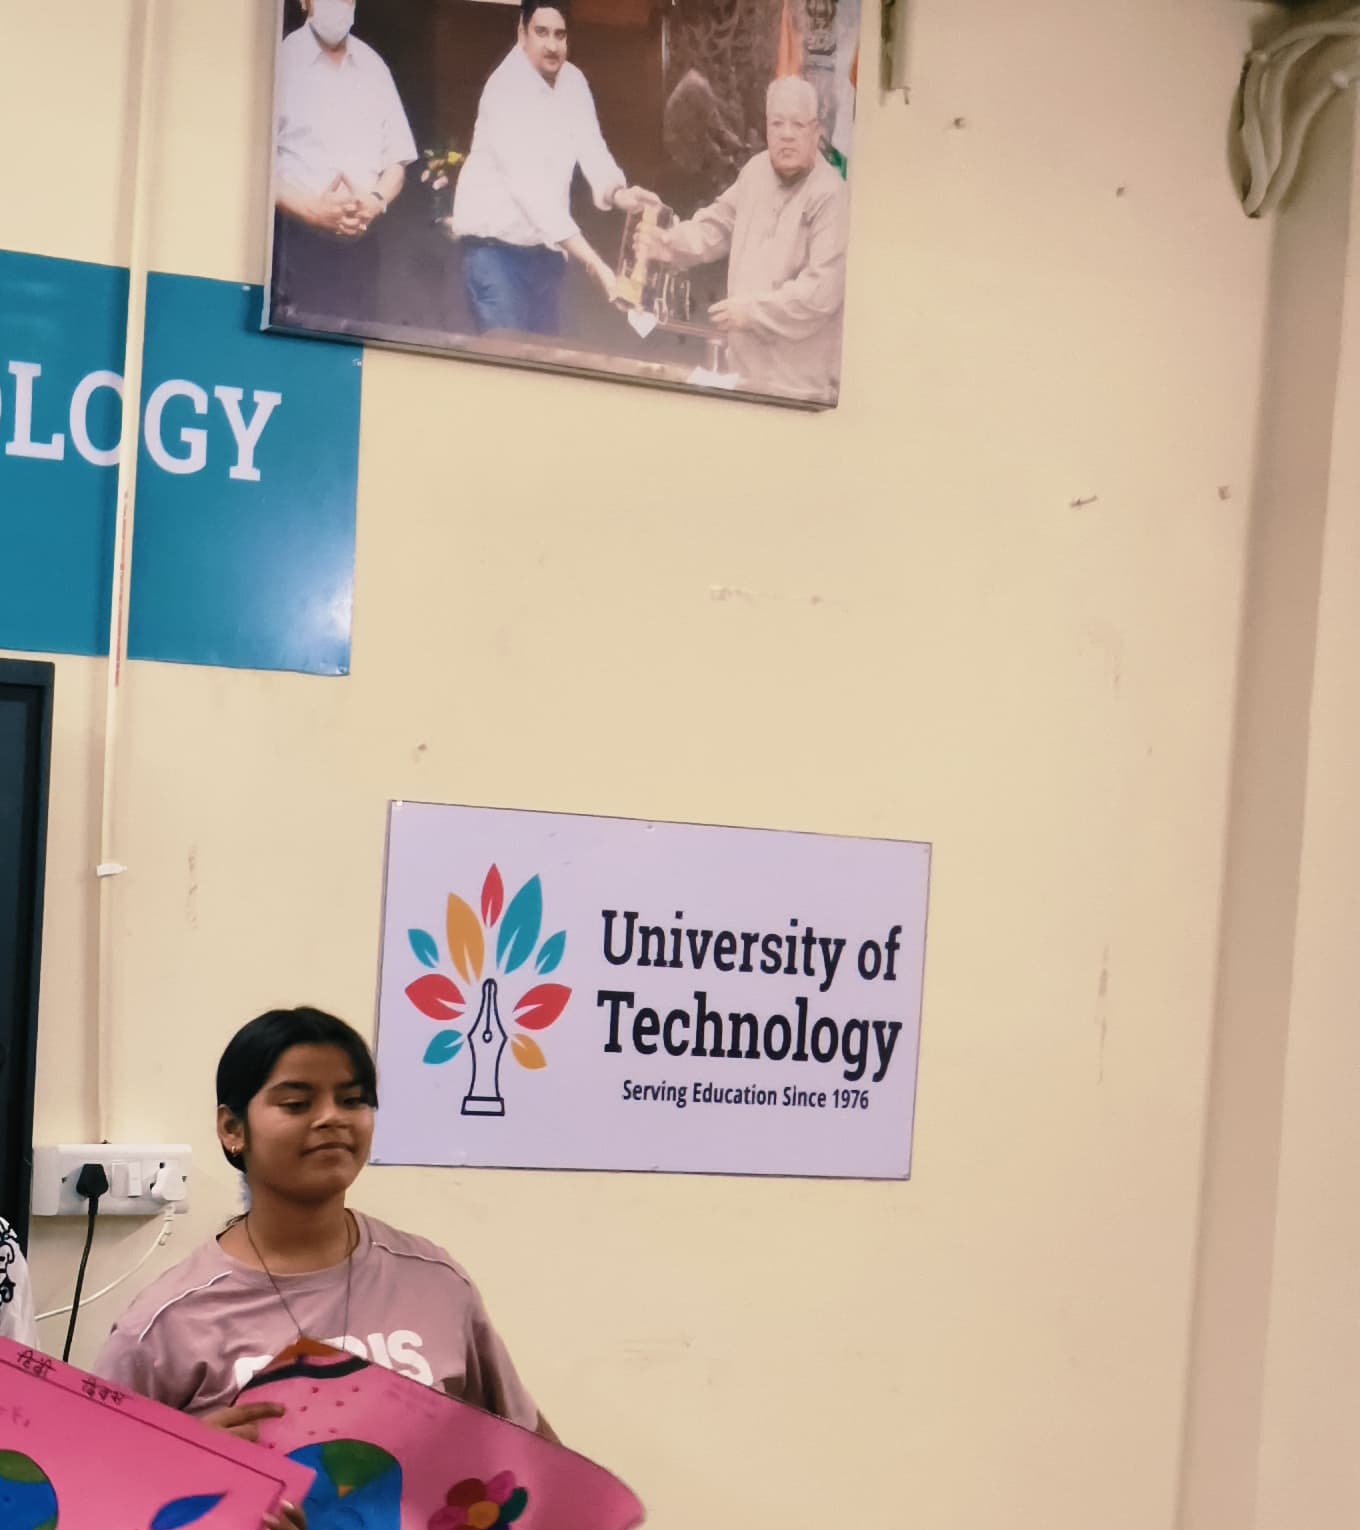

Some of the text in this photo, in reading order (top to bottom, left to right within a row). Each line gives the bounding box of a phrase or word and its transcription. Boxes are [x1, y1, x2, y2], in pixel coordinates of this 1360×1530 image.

[601, 909, 902, 992] University of
[597, 990, 903, 1083] Technology
[623, 1080, 869, 1110] Serving Education Since 1976
